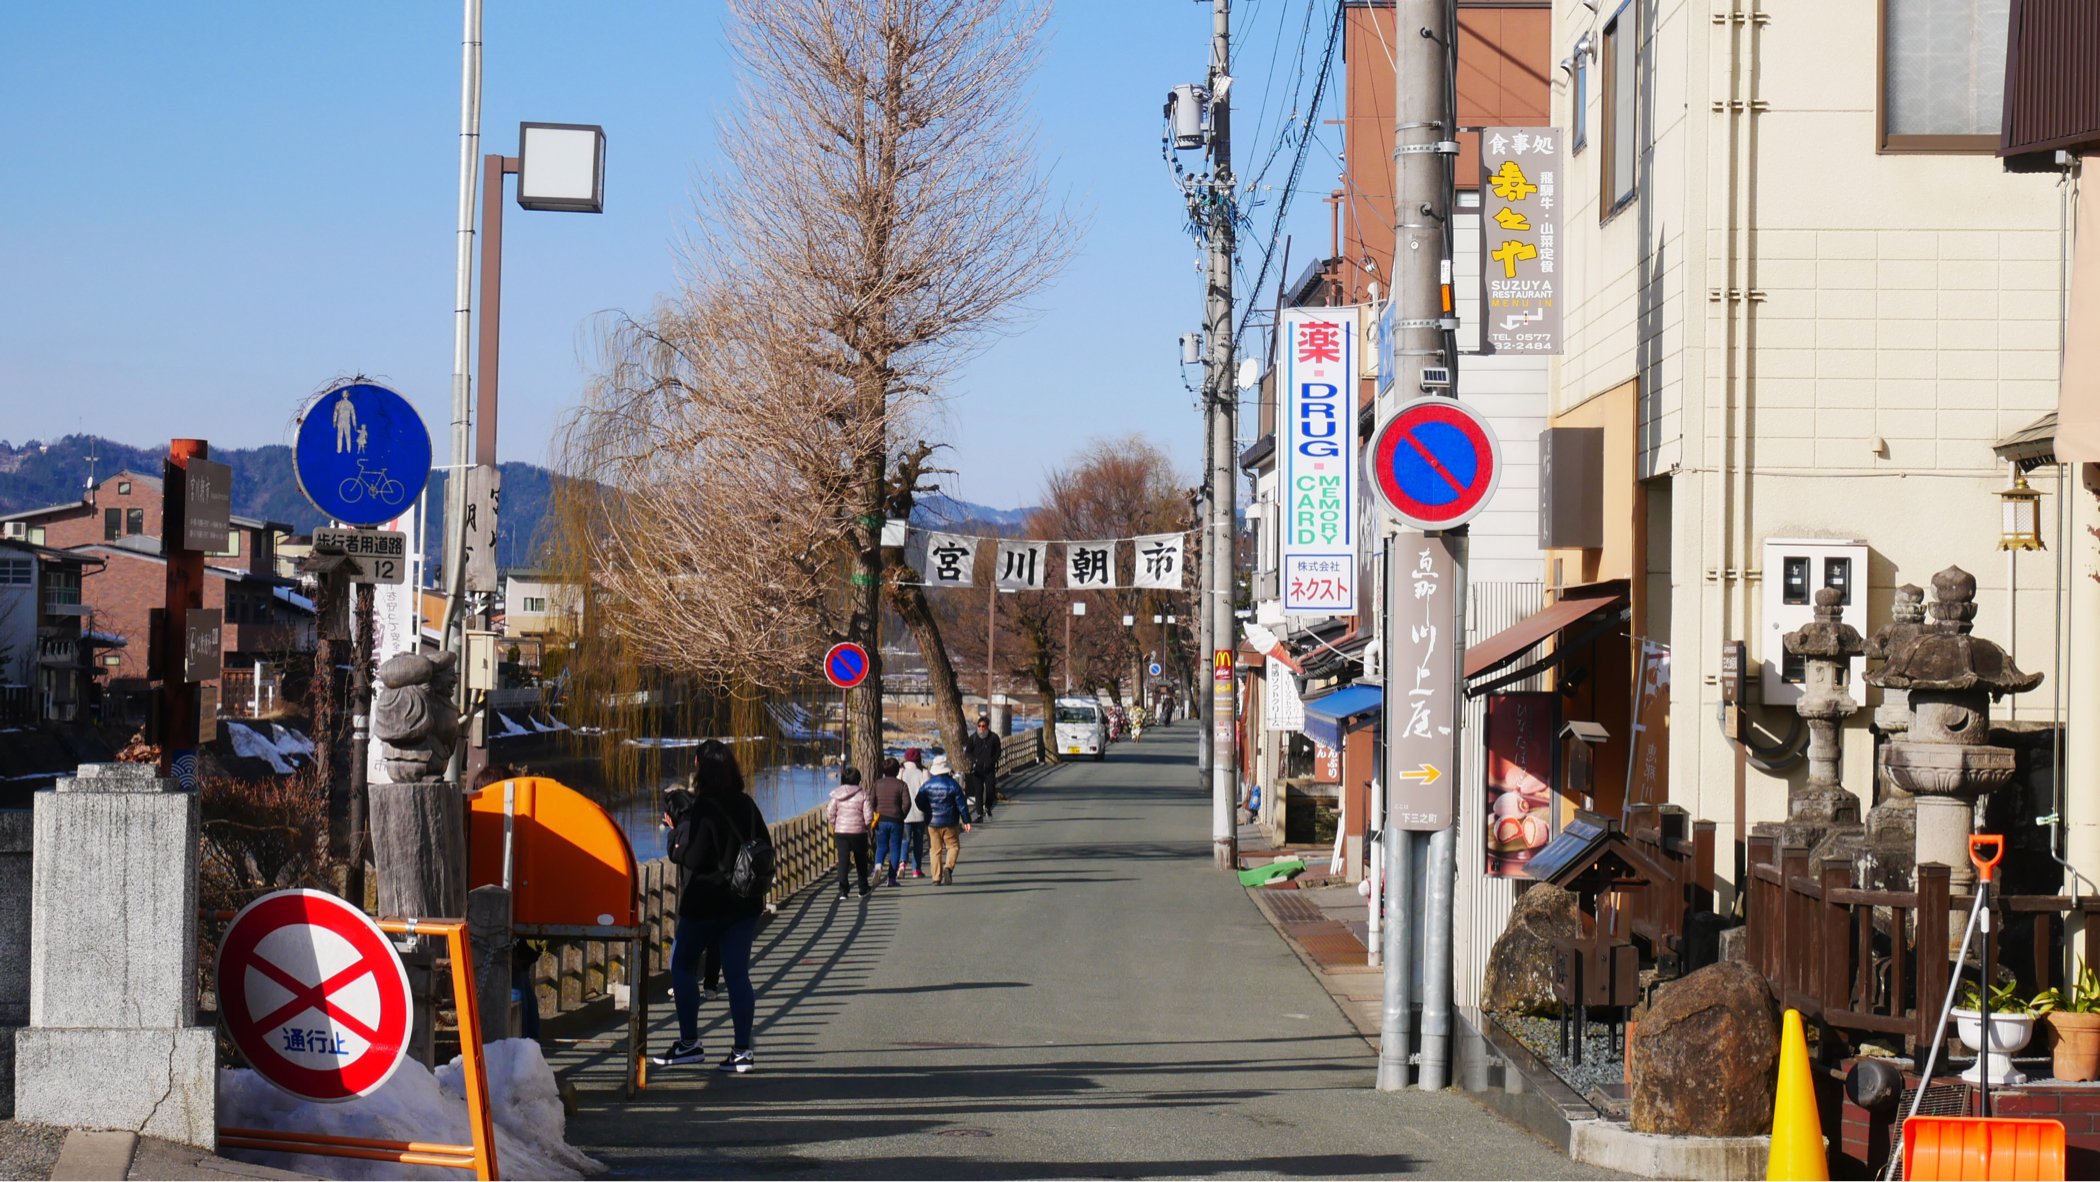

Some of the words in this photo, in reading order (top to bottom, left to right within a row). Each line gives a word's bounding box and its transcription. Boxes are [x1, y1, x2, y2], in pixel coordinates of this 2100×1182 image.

[1488, 133, 1555, 155] 食事処
[1539, 171, 1554, 273] 飛騨牛・山菜定食
[1491, 280, 1552, 290] SUZUYA
[1492, 290, 1553, 299] RESTAURANT
[1491, 298, 1530, 307] MENU
[1538, 298, 1553, 307] IN
[1297, 321, 1341, 364] 薬
[1492, 333, 1512, 341] TEL
[1516, 333, 1552, 341] 0577
[1493, 342, 1552, 350] 32-2484
[1300, 382, 1340, 457] DRUG
[1296, 475, 1316, 545] CARD
[1319, 475, 1341, 545] MEMORY
[316, 533, 403, 555] 歩行者用道路
[374, 560, 395, 579] 12
[932, 542, 1178, 586] 宮川朝市
[1297, 561, 1341, 572] 株式会社
[1290, 576, 1348, 602] ネクスト
[1401, 812, 1438, 824] 下三之町
[282, 1027, 350, 1056] 通行止
